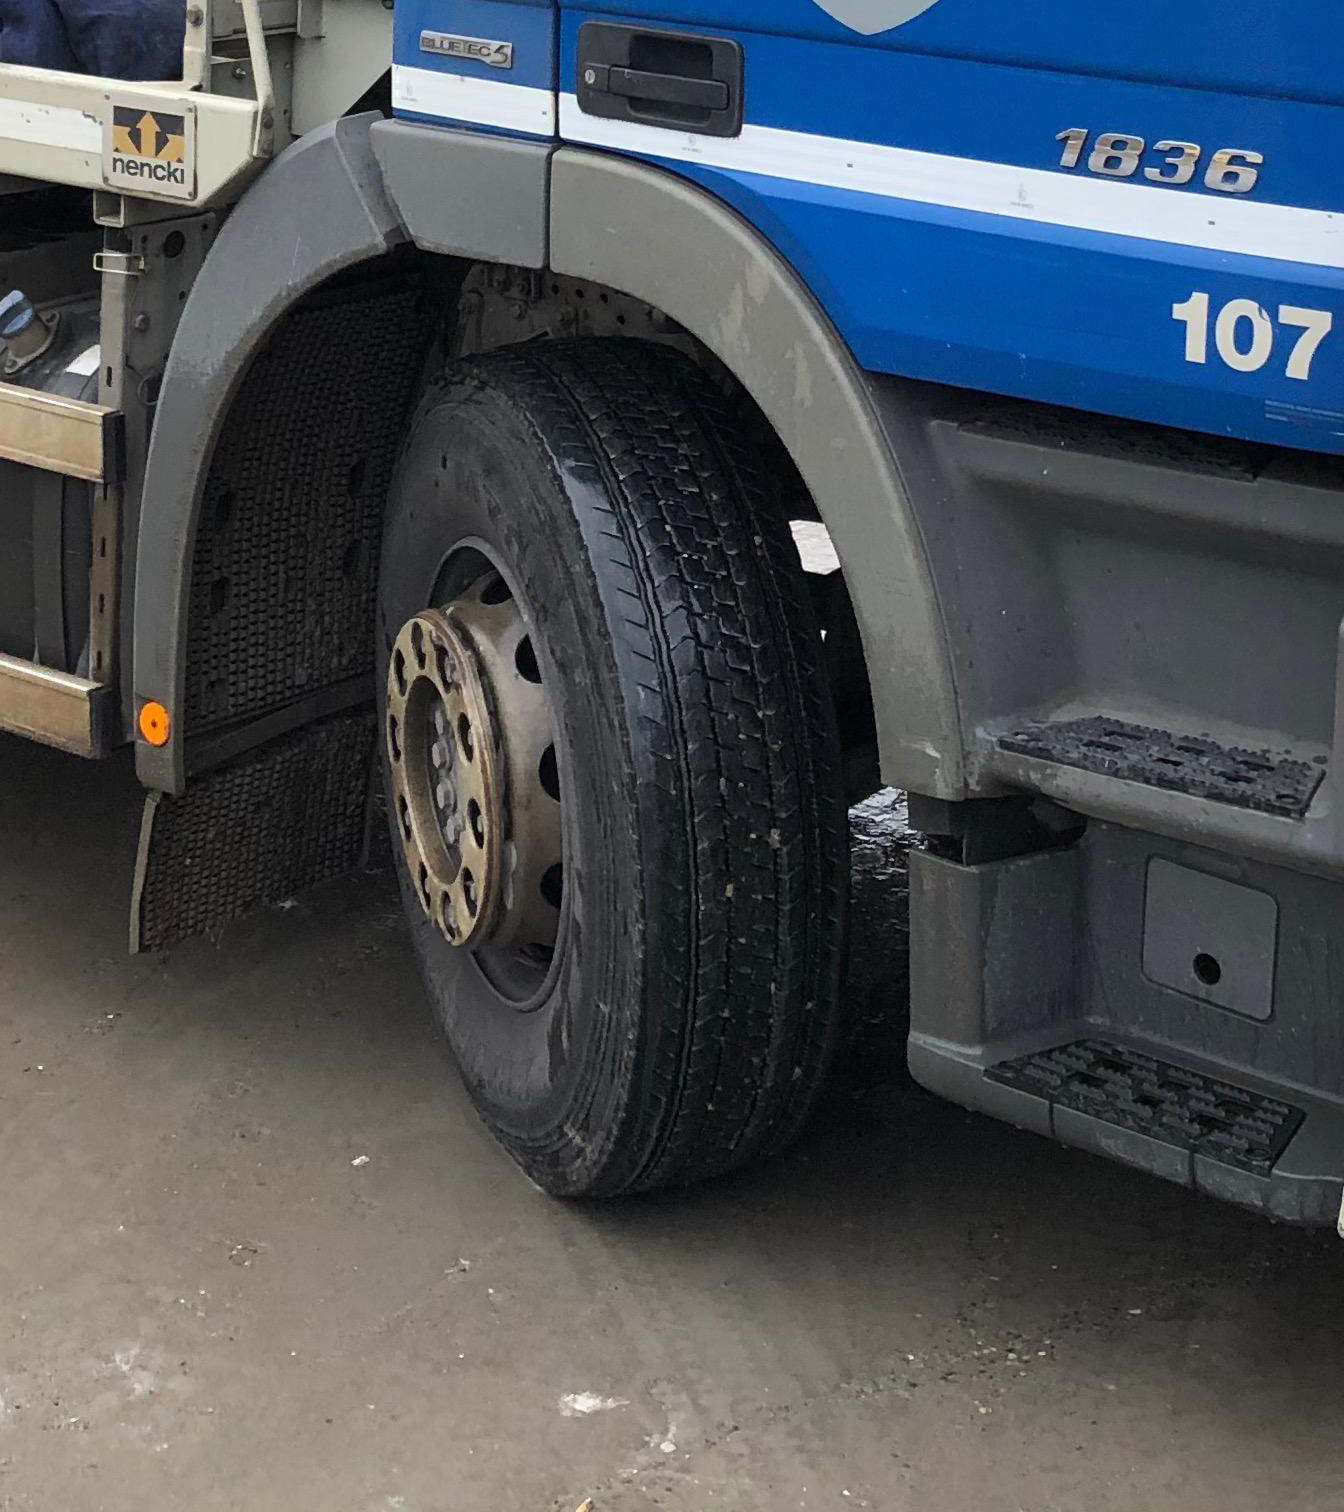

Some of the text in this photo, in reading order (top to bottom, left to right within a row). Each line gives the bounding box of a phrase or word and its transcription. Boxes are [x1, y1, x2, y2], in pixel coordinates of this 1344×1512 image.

[111, 156, 185, 185] nencki
[1055, 127, 1264, 194] 1836
[1171, 291, 1333, 380] 107
